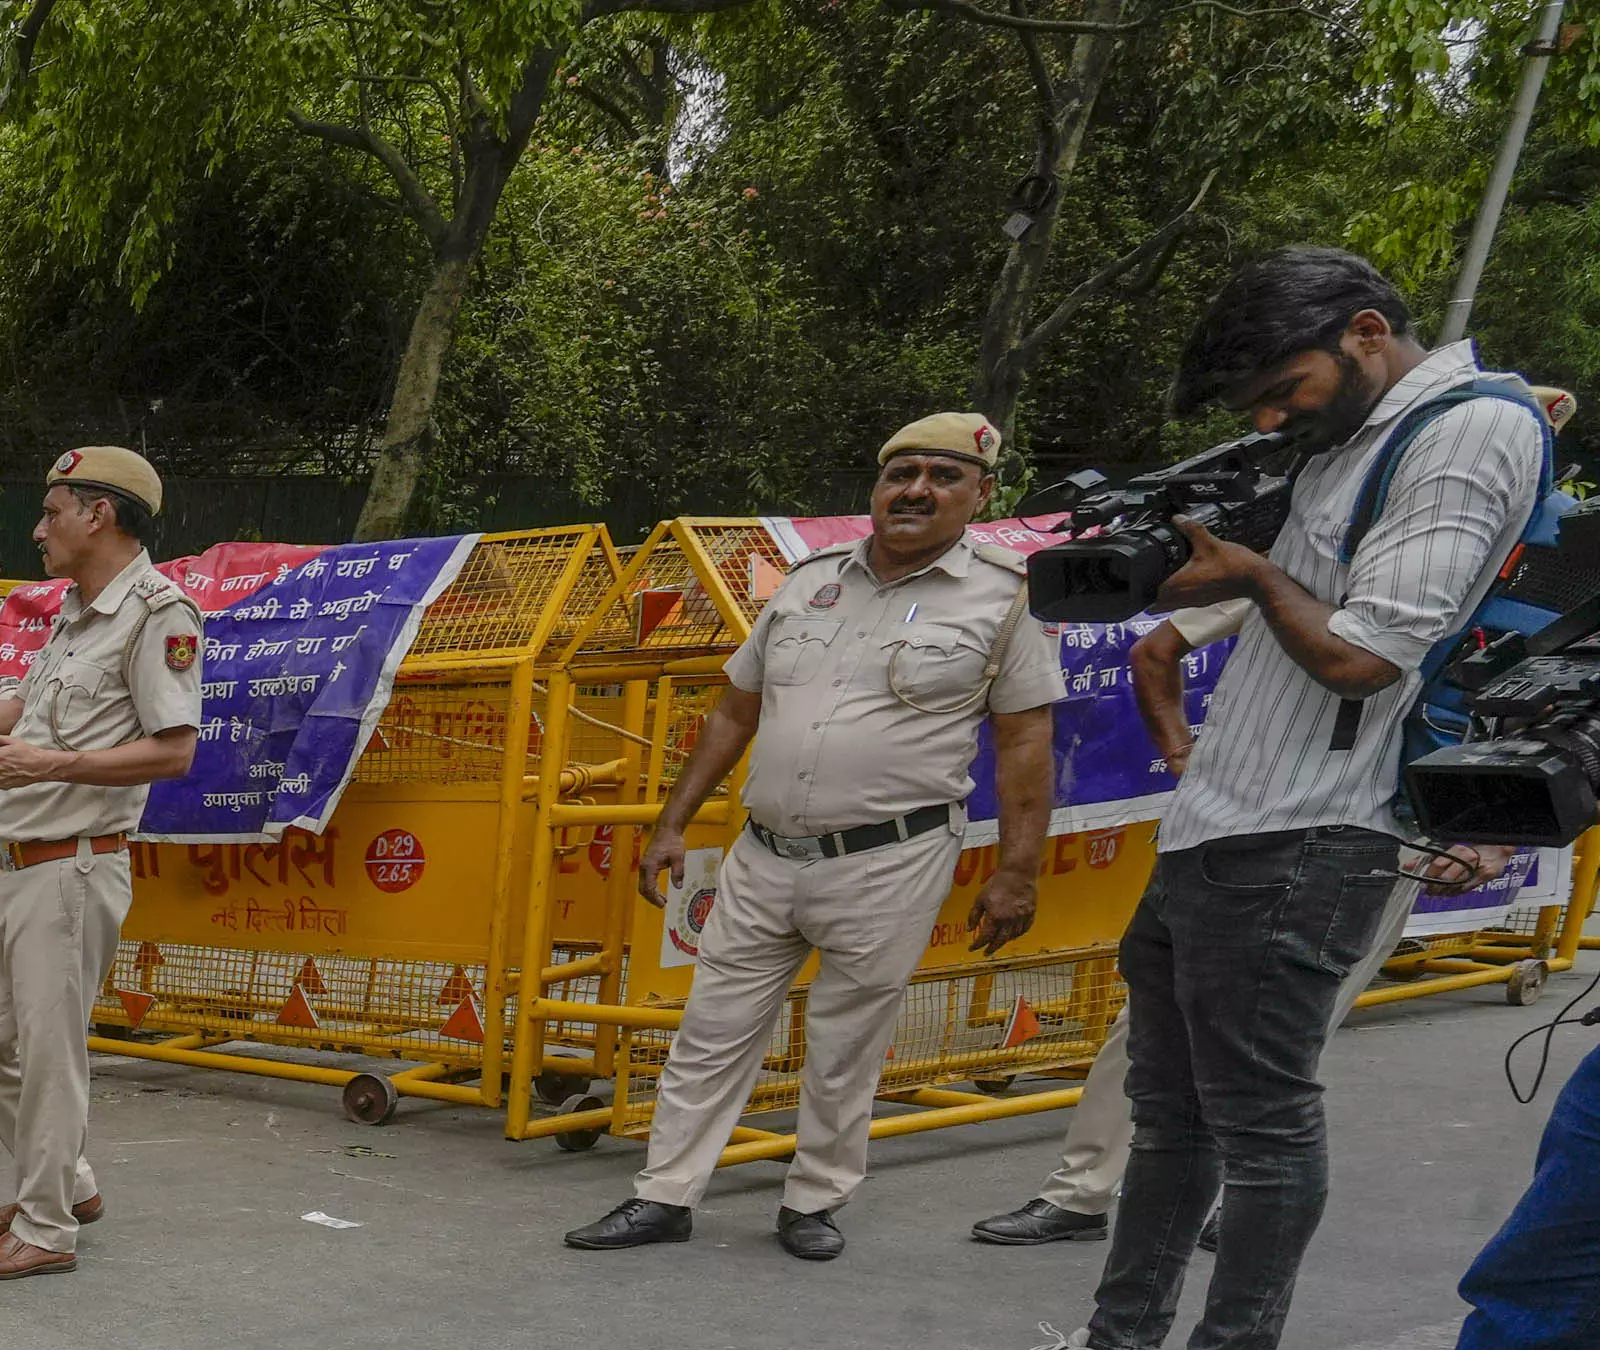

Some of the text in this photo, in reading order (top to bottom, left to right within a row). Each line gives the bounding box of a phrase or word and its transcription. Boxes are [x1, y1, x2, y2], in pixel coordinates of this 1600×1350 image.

[220, 572, 271, 591] जाता
[296, 558, 329, 581] कि
[295, 635, 324, 655] या
